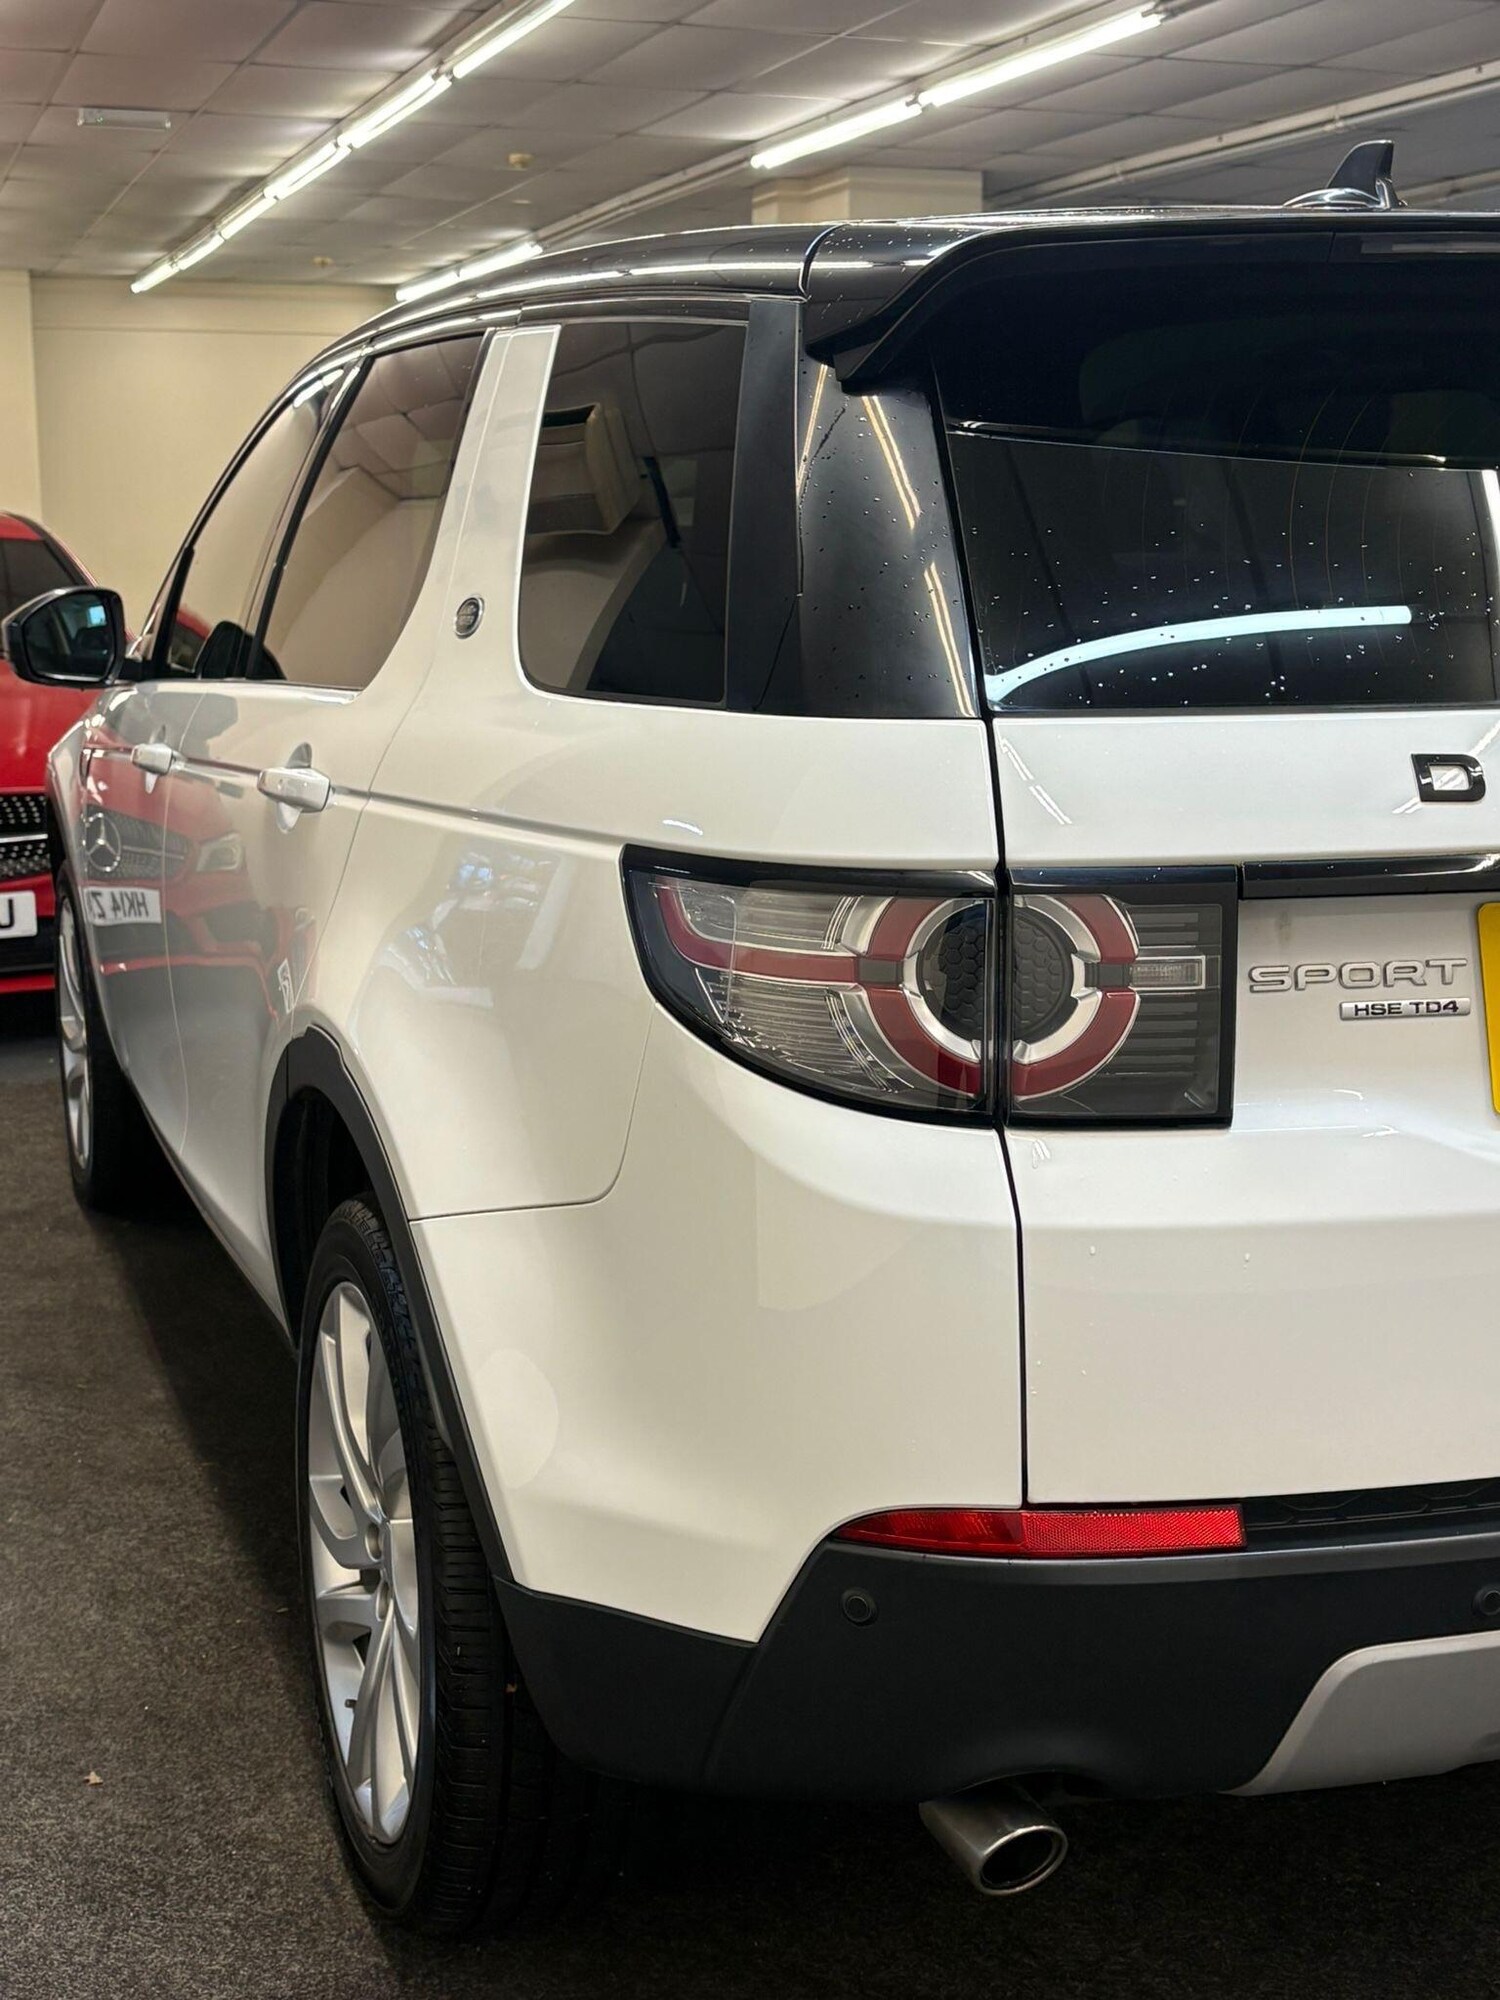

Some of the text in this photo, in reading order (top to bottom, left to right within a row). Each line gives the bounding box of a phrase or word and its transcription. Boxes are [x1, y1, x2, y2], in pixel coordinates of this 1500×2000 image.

[1411, 753, 1486, 802] D
[1249, 958, 1468, 993] SPORT
[1353, 1000, 1459, 1017] HSE TD4
